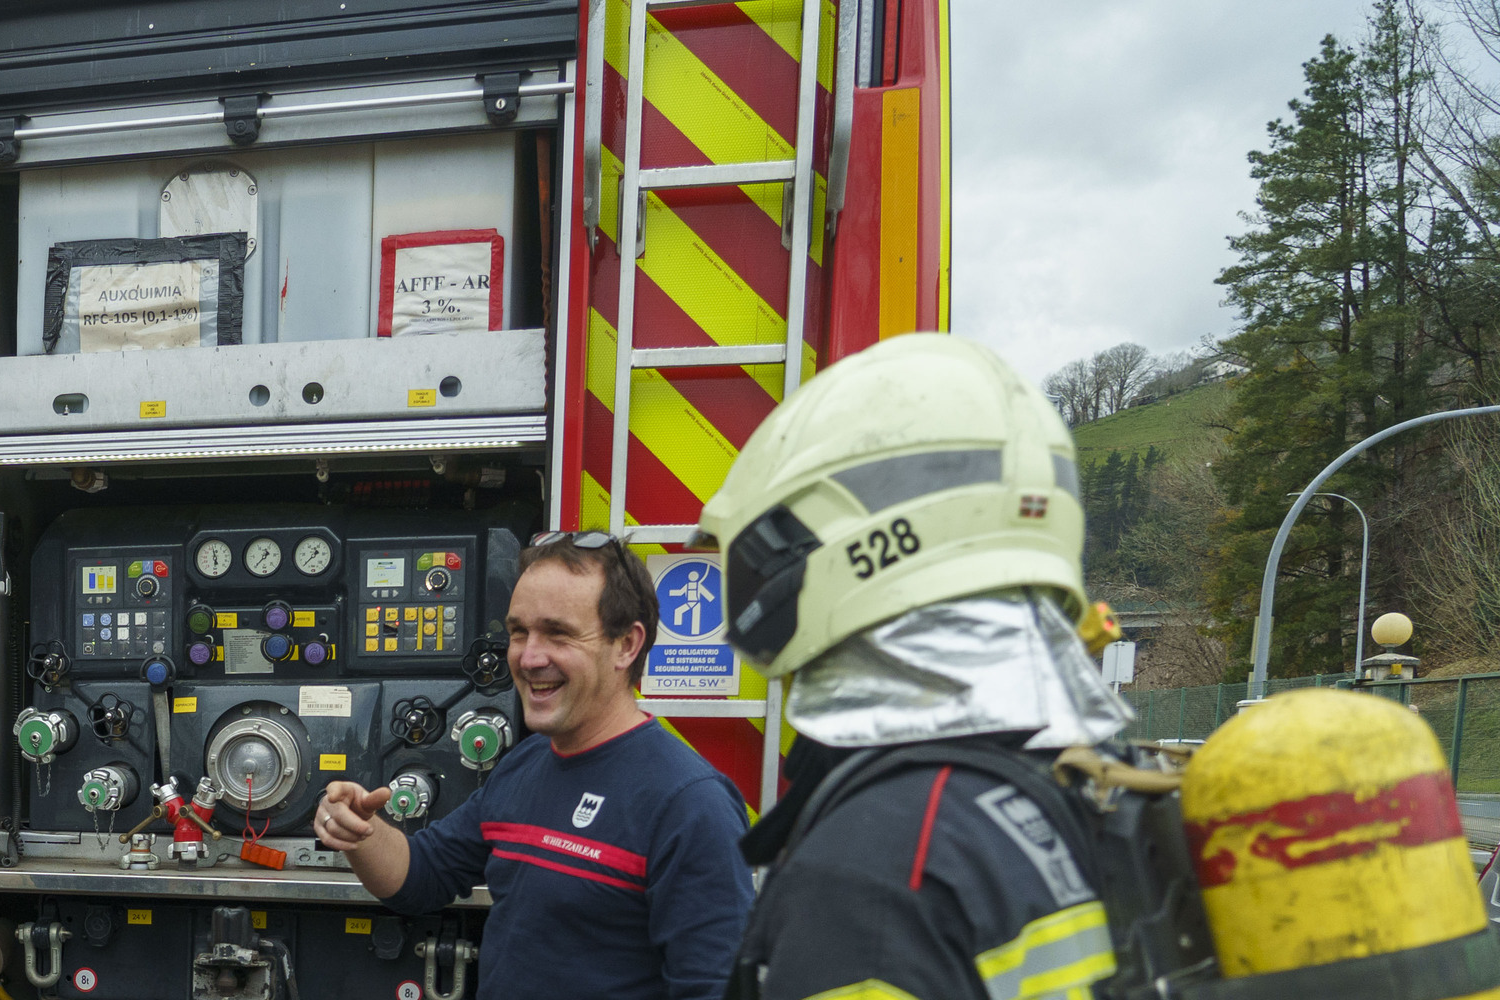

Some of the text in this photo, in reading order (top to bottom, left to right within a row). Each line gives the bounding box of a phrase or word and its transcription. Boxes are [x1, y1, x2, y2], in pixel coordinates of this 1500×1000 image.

[396, 276, 446, 293] AFFF
[462, 274, 490, 290] AR
[98, 285, 182, 302] AUXQUIMIA
[421, 299, 431, 314] 3
[83, 306, 198, 326] RFC-105 (0,1-1%)
[846, 518, 921, 580] 528
[664, 648, 719, 656] USO OBLIGATORIO
[655, 665, 727, 673] SEGURIDAD ANTICAIDAS
[655, 678, 696, 688] TOTAL
[132, 913, 147, 921] 24 V
[81, 975, 90, 985] 8t
[404, 988, 413, 999] 8t
